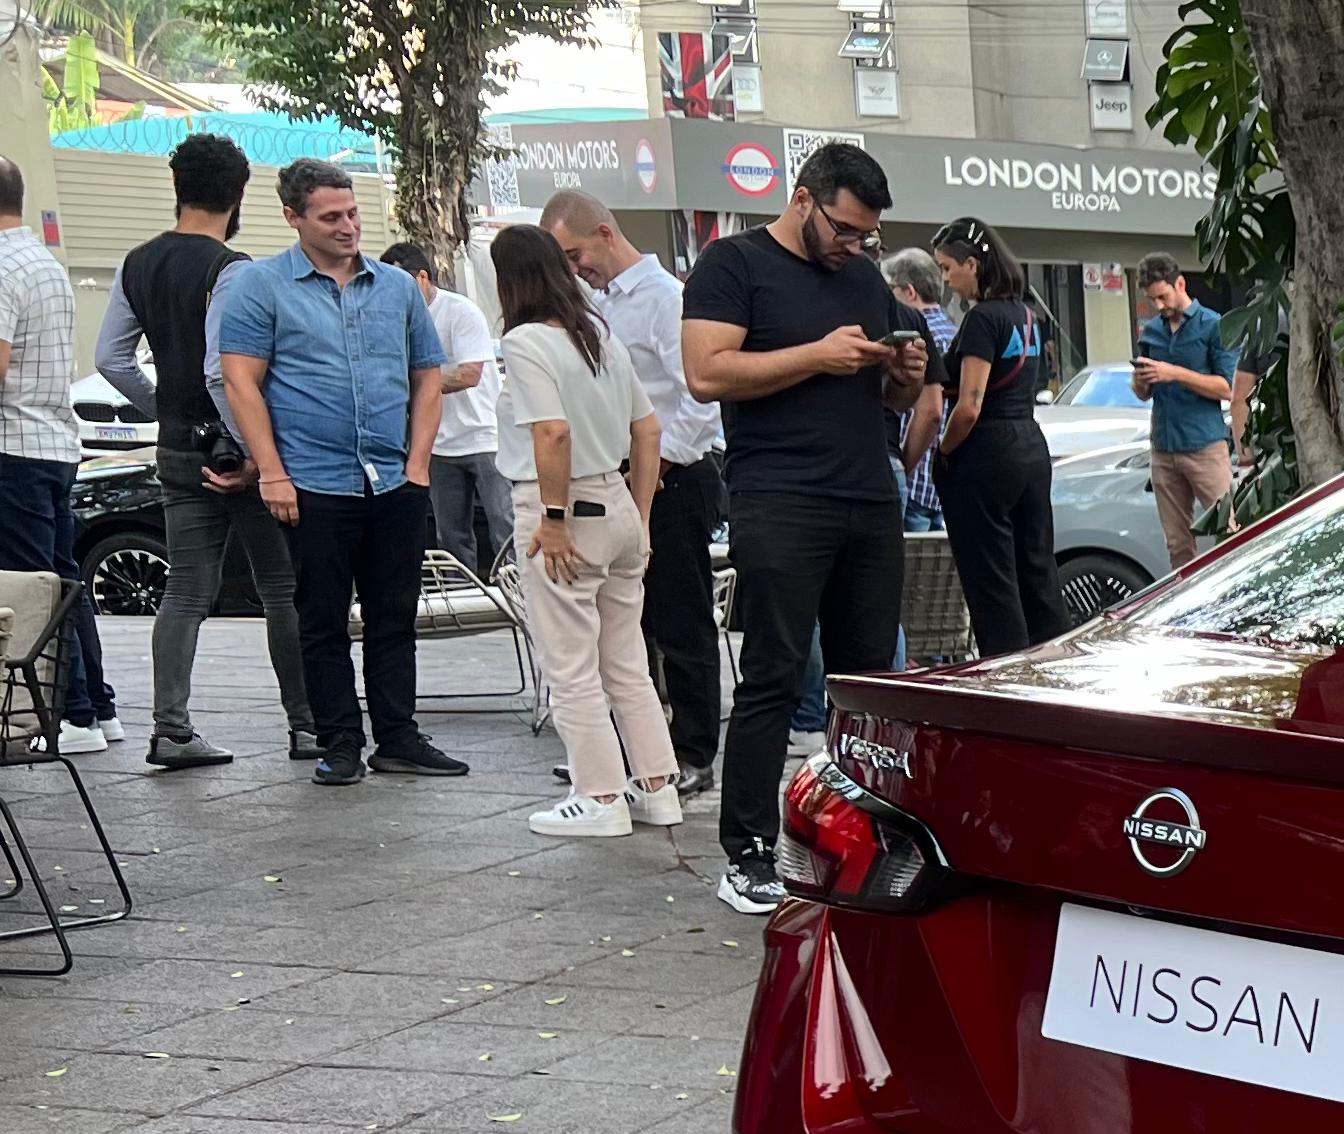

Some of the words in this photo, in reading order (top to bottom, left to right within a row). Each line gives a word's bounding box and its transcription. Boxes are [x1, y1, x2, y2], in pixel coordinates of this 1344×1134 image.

[1096, 98, 1128, 113] Jeep
[565, 139, 619, 169] MOTORS
[553, 170, 582, 188] EUROPA
[730, 164, 774, 177] LONDON
[943, 155, 1082, 193] LONDON
[1091, 163, 1218, 200] MOTORS
[1052, 191, 1121, 213] EUROPA
[1123, 819, 1202, 847] NISSAN
[1090, 954, 1320, 1054] NISSAN
